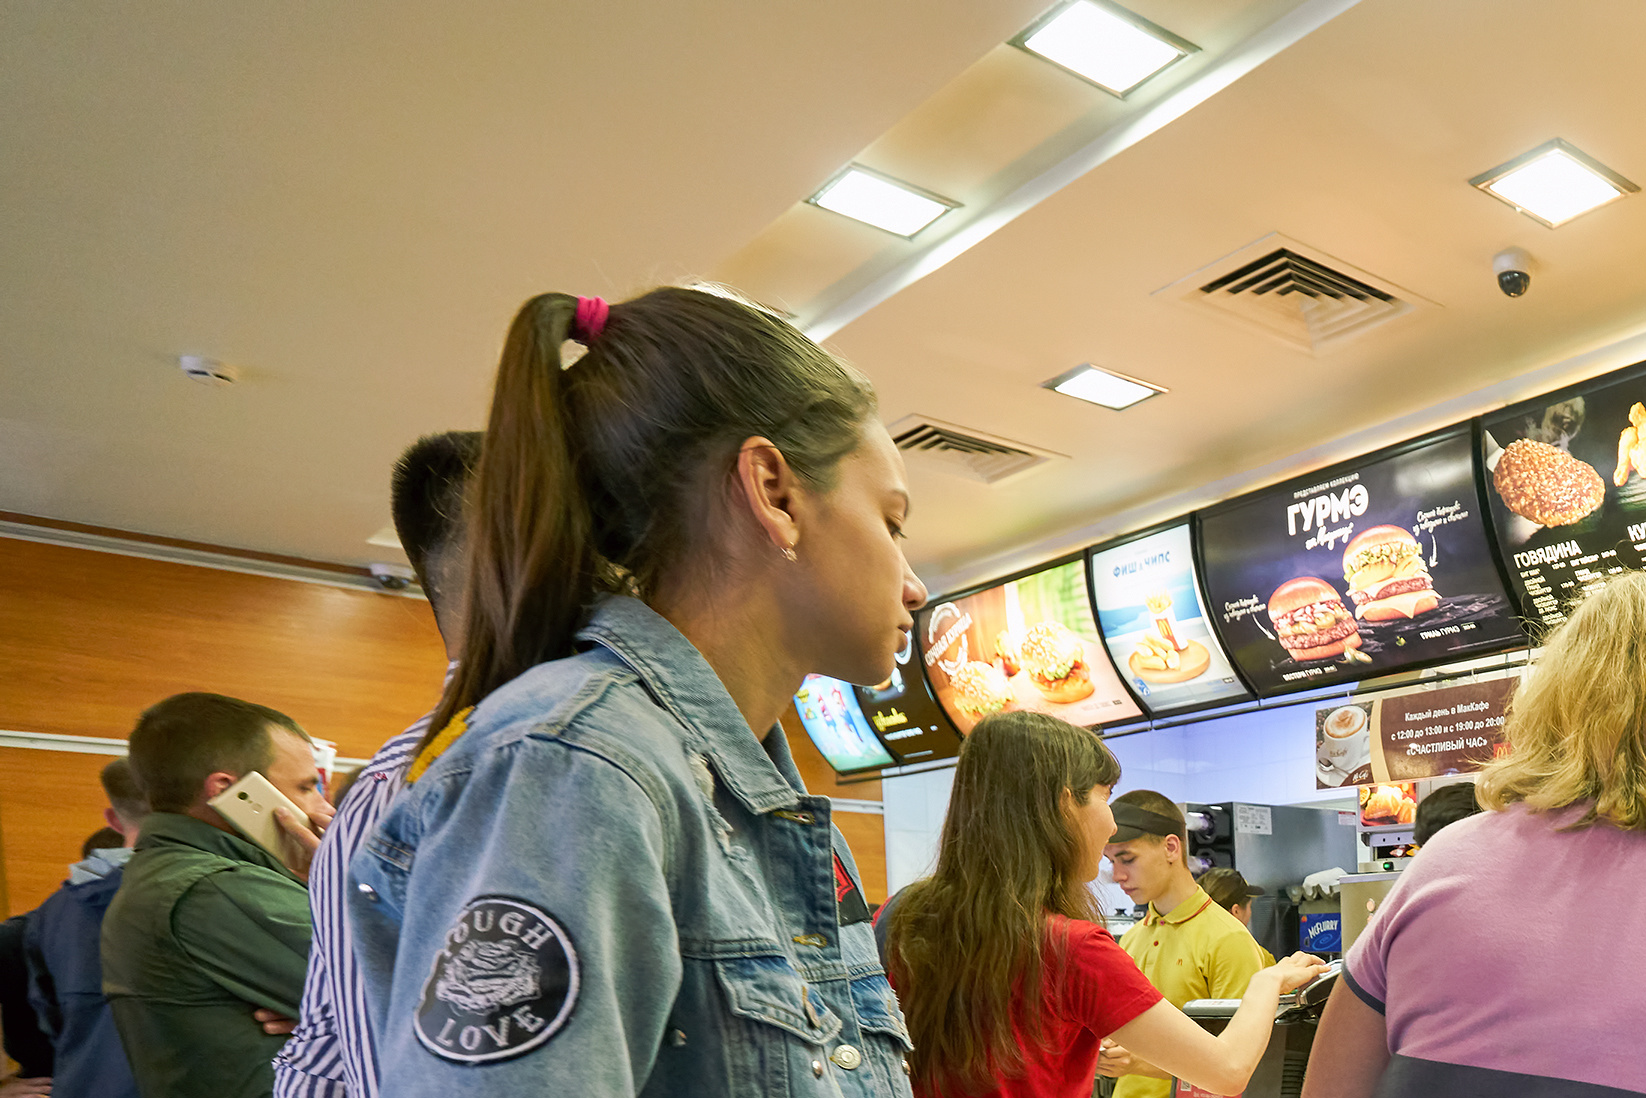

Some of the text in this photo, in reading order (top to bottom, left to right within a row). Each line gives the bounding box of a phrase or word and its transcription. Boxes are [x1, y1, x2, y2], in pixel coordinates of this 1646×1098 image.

[1286, 483, 1369, 537] ГУРМЭ
[1113, 551, 1171, 578] ФИШ ЧИПС
[1513, 539, 1583, 569] ГОВЯДИНА
[1405, 700, 1489, 722] Каждый день в МакКафе
[1391, 733, 1396, 741] с
[1397, 729, 1414, 740] 12:00
[1414, 728, 1424, 739] до
[1425, 724, 1443, 736] 13:00
[1449, 725, 1455, 733] с
[1455, 720, 1474, 732] 19:00
[1474, 720, 1484, 730] до
[1485, 716, 1505, 728] 20:00
[435, 1005, 546, 1051] LOVE
